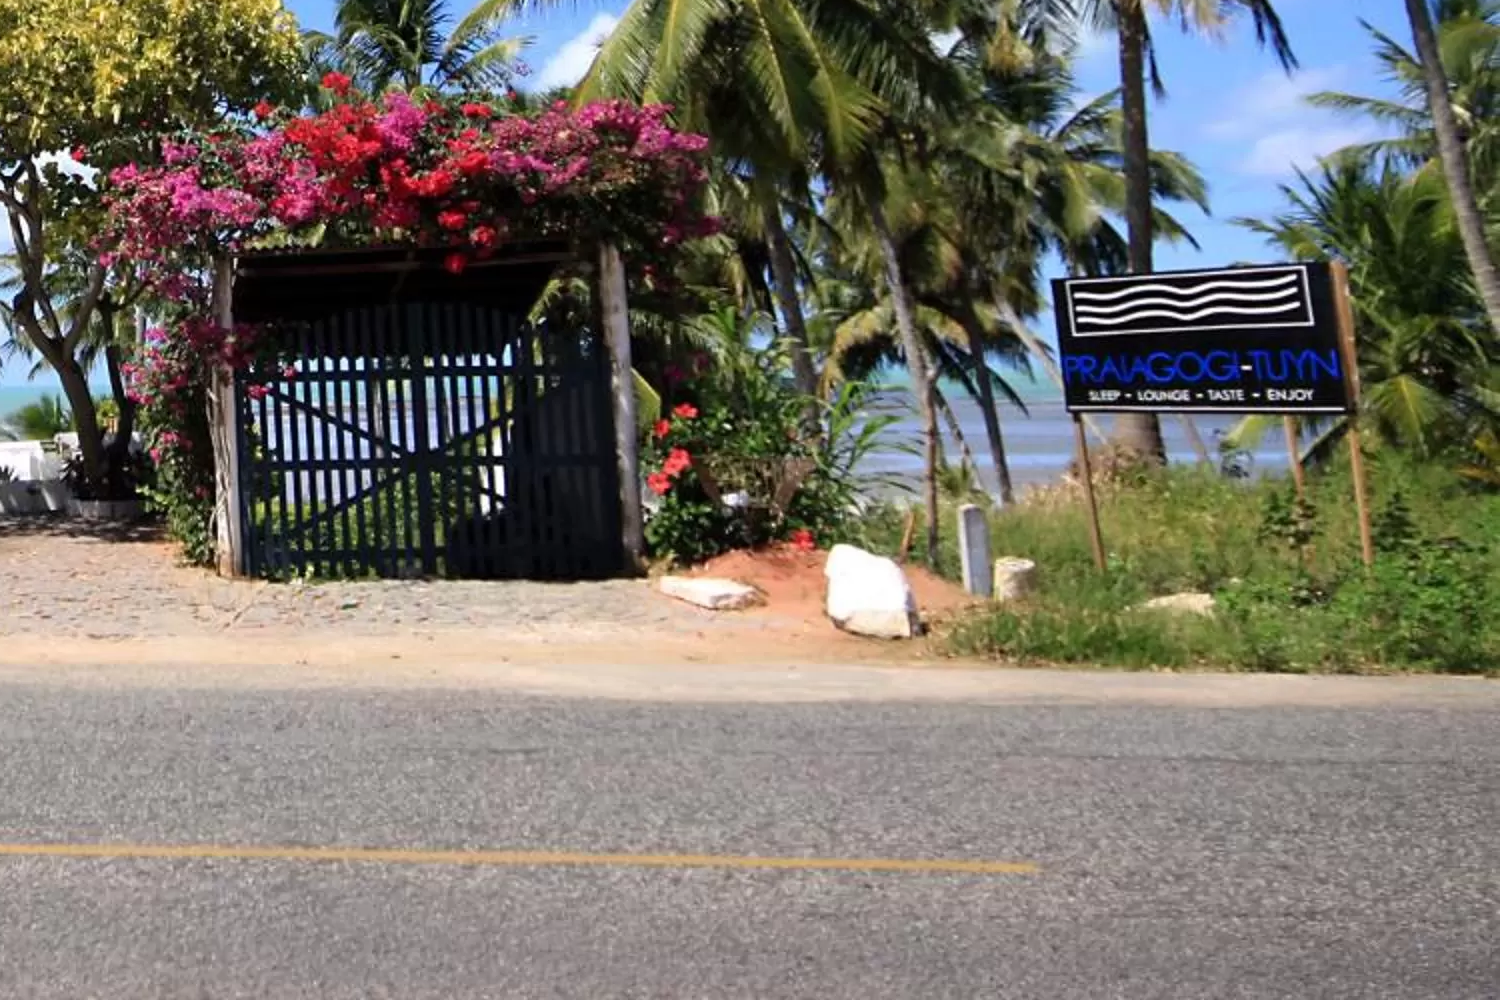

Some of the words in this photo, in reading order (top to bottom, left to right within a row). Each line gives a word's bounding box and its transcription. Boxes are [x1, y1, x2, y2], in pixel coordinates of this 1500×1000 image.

[1088, 389, 1121, 401] SLEEP
[1137, 389, 1191, 401] LOUNGE
[1208, 389, 1245, 401] TASTE
[1267, 388, 1314, 400] ENJOY
